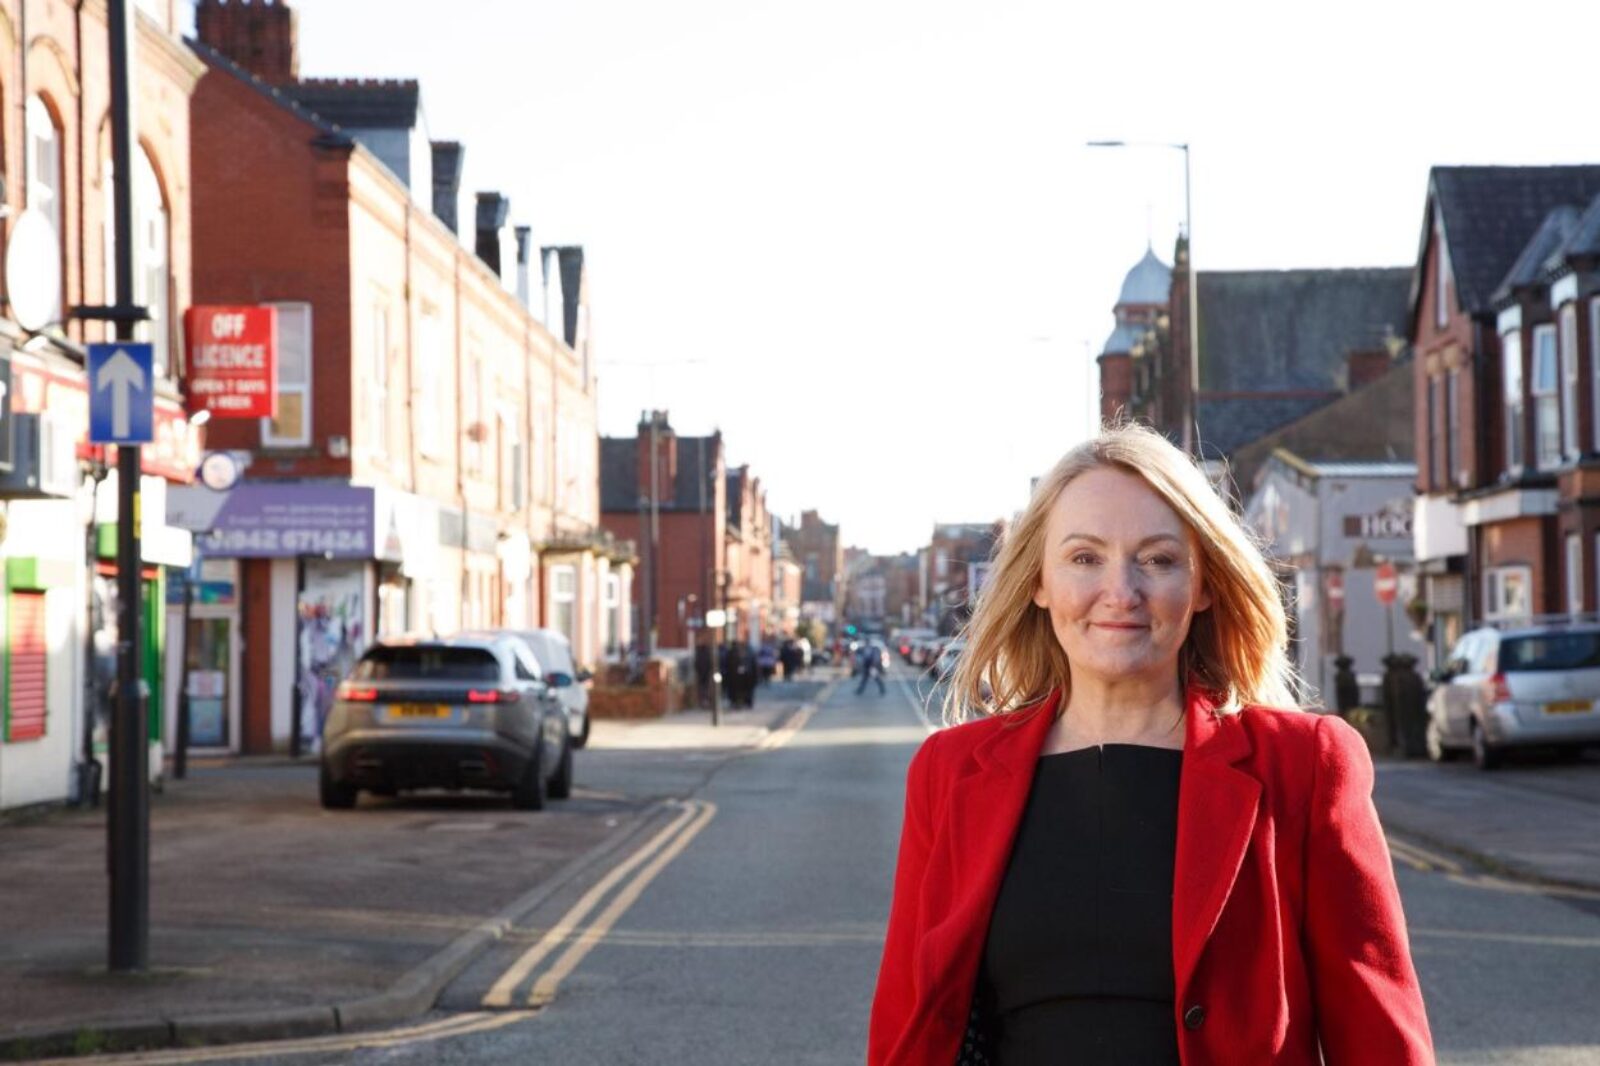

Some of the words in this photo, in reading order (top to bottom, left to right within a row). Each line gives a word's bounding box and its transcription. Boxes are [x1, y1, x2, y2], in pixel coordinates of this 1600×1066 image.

[211, 313, 246, 338] OFF
[192, 344, 265, 368] LICENCE
[191, 379, 225, 394] OPEN
